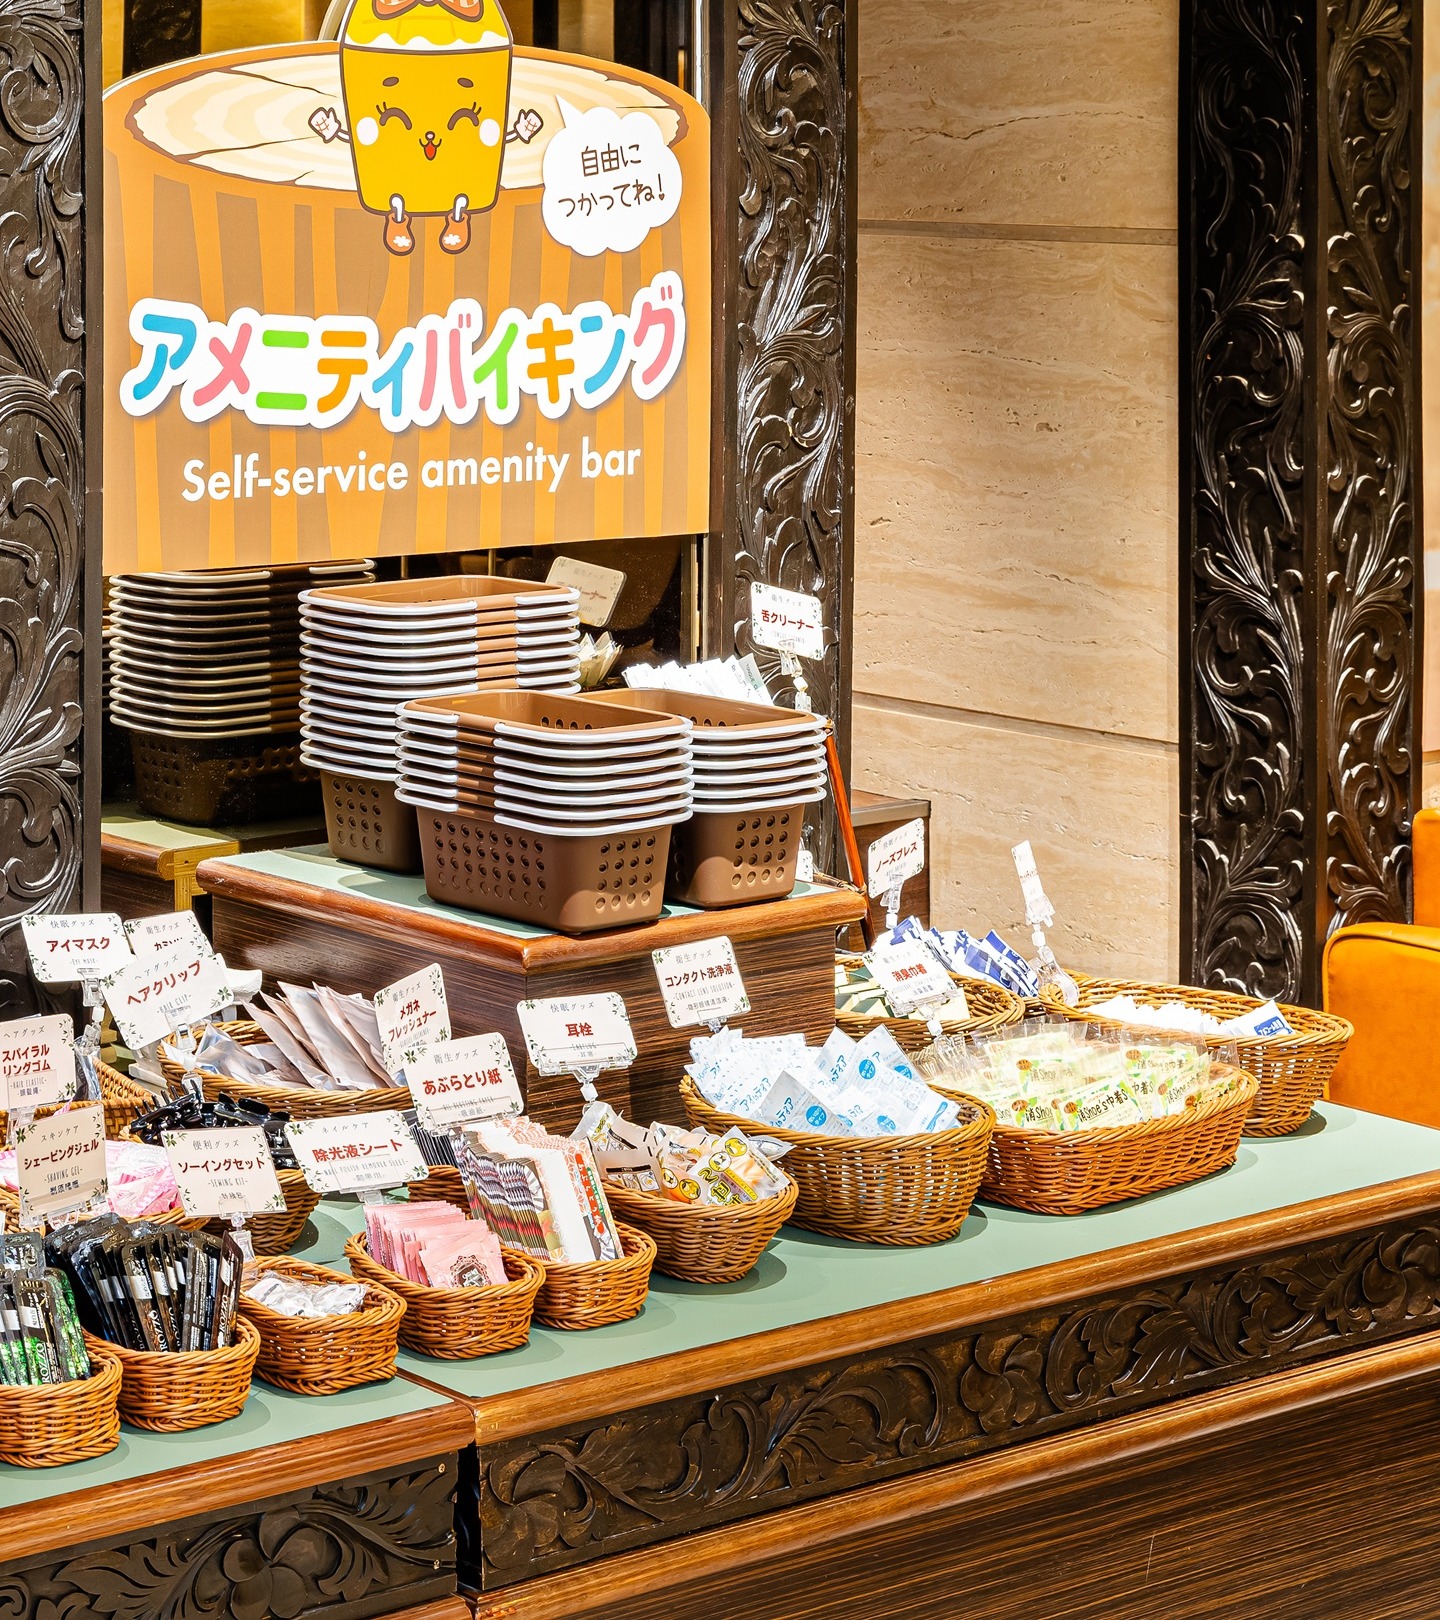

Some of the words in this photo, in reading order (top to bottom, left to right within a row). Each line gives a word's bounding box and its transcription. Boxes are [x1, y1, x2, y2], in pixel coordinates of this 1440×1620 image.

[579, 144, 641, 177] 自由に
[133, 285, 675, 418] アメニティバイキング
[181, 452, 409, 501] Self-service
[422, 441, 565, 492] amenity
[580, 436, 641, 479] bar
[761, 609, 814, 630] 舌クリーナー
[50, 918, 95, 929] 快眠グッズ
[46, 936, 111, 953] アイマスク
[134, 954, 180, 981] ヘアグッズ
[665, 963, 735, 989] コンタクト洗浄液
[127, 959, 203, 1007] ヘアクリップ
[400, 998, 421, 1020] メガネ
[550, 1001, 595, 1013] 快眠グッズ
[3, 1025, 46, 1040] ヘアグッズ
[388, 1010, 437, 1043] フレッシュナー
[566, 1022, 594, 1038] 耳栓
[2, 1044, 51, 1063] スパイラル
[433, 1048, 479, 1065] 衛生グッズ
[2, 1058, 51, 1077] リングゴム
[423, 1068, 503, 1097] あぶらとり紙
[40, 1126, 80, 1144] スキンケア
[321, 1121, 369, 1134] ネイルケア
[24, 1138, 100, 1171] シェービングジェル
[192, 1139, 240, 1152] 便利グッズ
[312, 1138, 404, 1163] 除光液シート
[177, 1156, 266, 1175] ソーイングセット
[577, 1159, 605, 1233] あぶらとり紙
